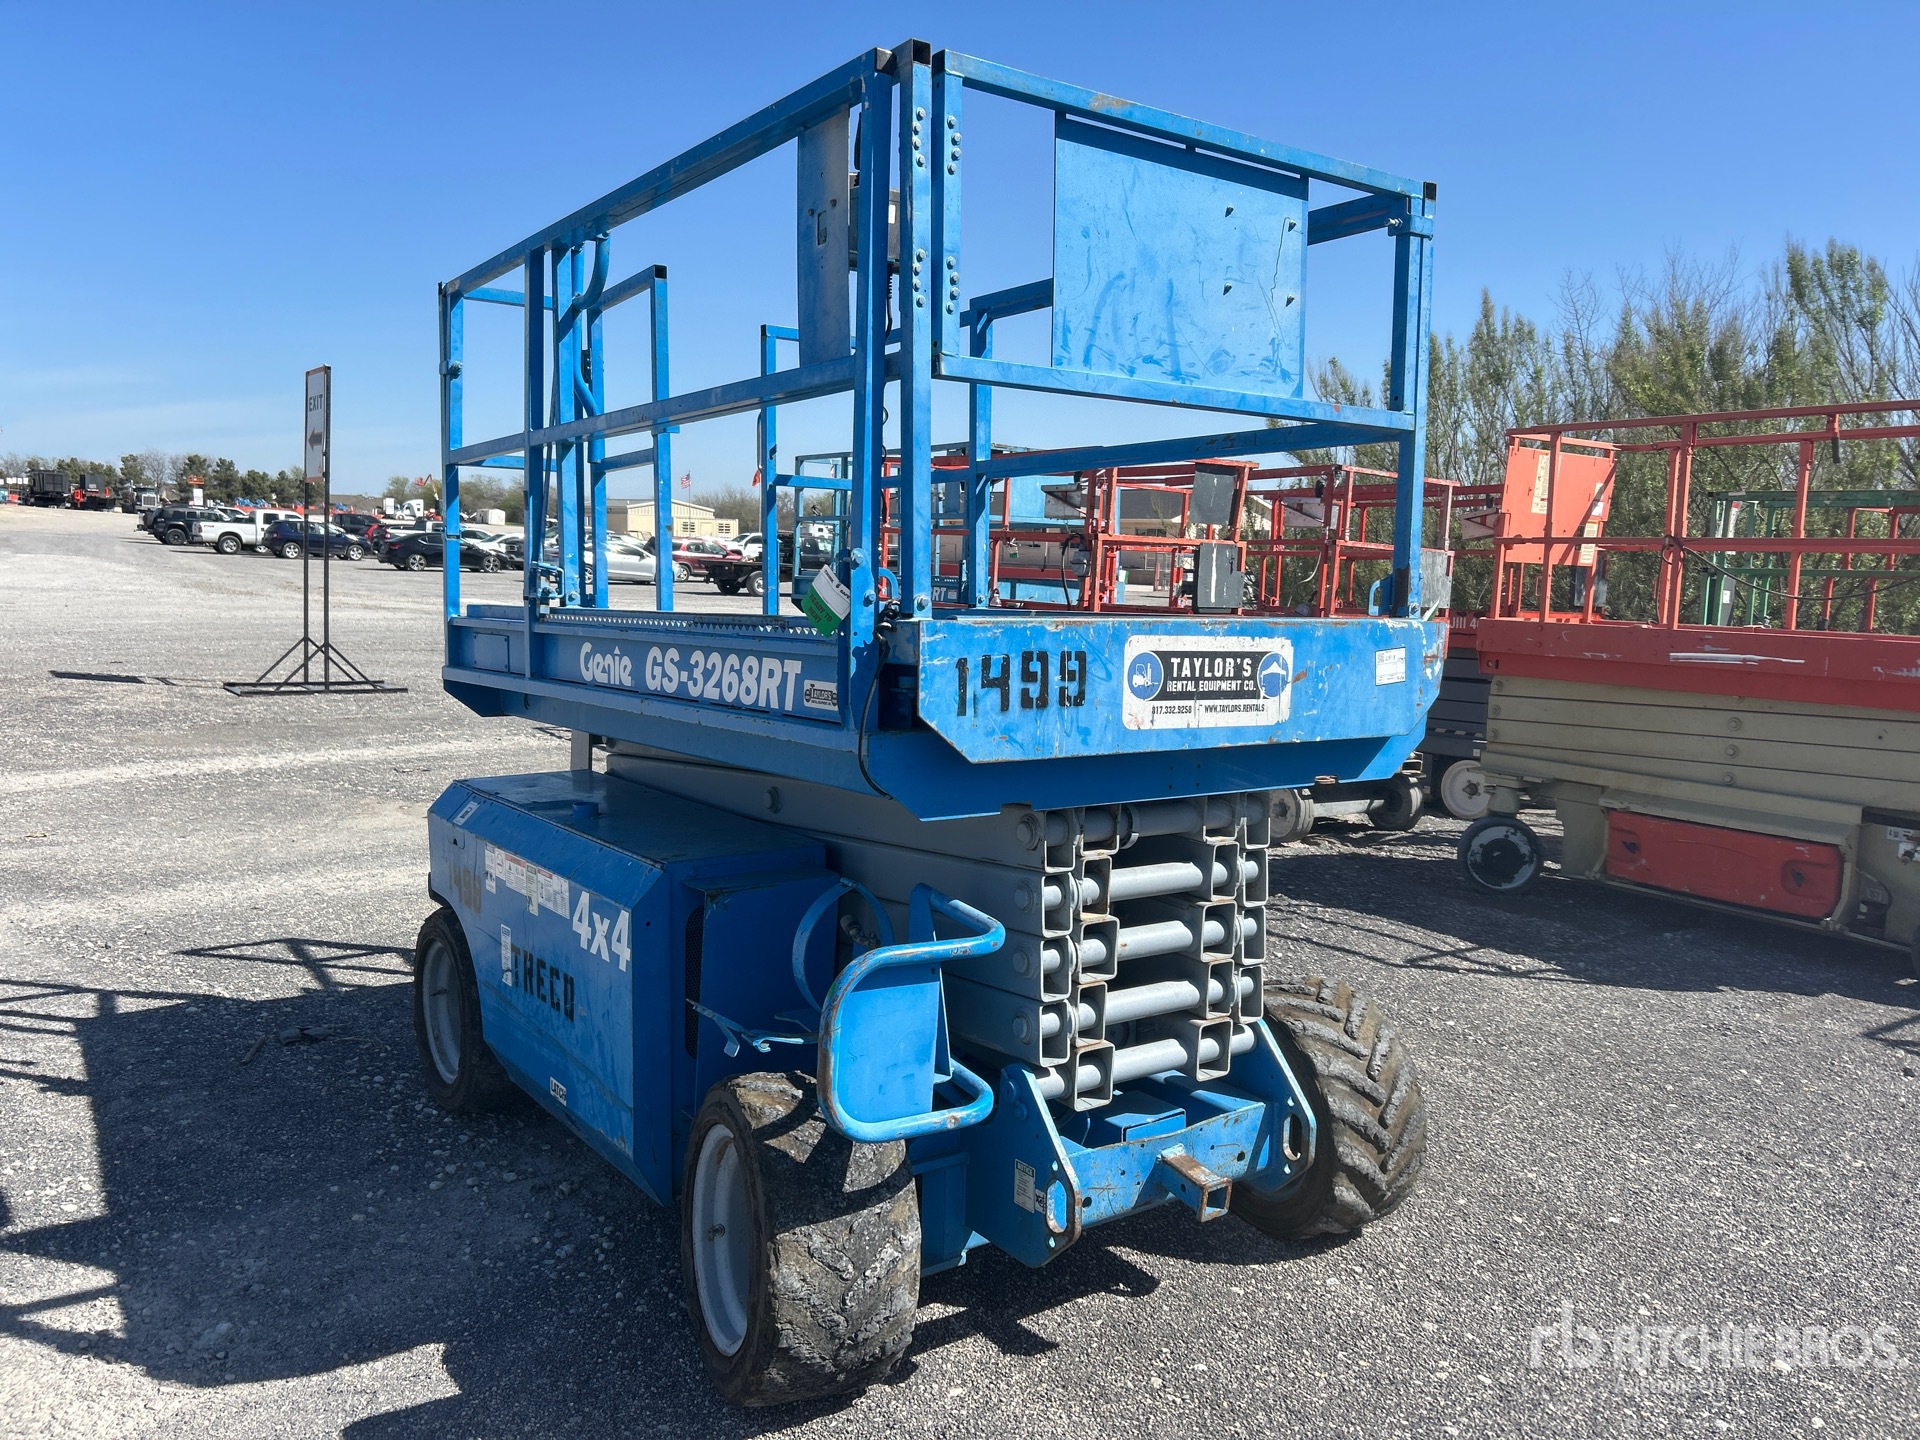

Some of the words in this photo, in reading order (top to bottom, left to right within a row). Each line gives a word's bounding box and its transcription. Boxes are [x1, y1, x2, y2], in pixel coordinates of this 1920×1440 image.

[309, 394, 323, 412] EXIT
[579, 641, 633, 687] Genie
[645, 645, 802, 711] GS-3268RT
[1170, 657, 1253, 678] TAYLOR'S
[955, 650, 1087, 716] 1499
[1166, 680, 1197, 692] RENTAL
[1199, 680, 1241, 692] EQUIPMENT
[1243, 680, 1257, 691] CO.
[572, 890, 631, 972] 4x4
[551, 1079, 567, 1102] LATCH
